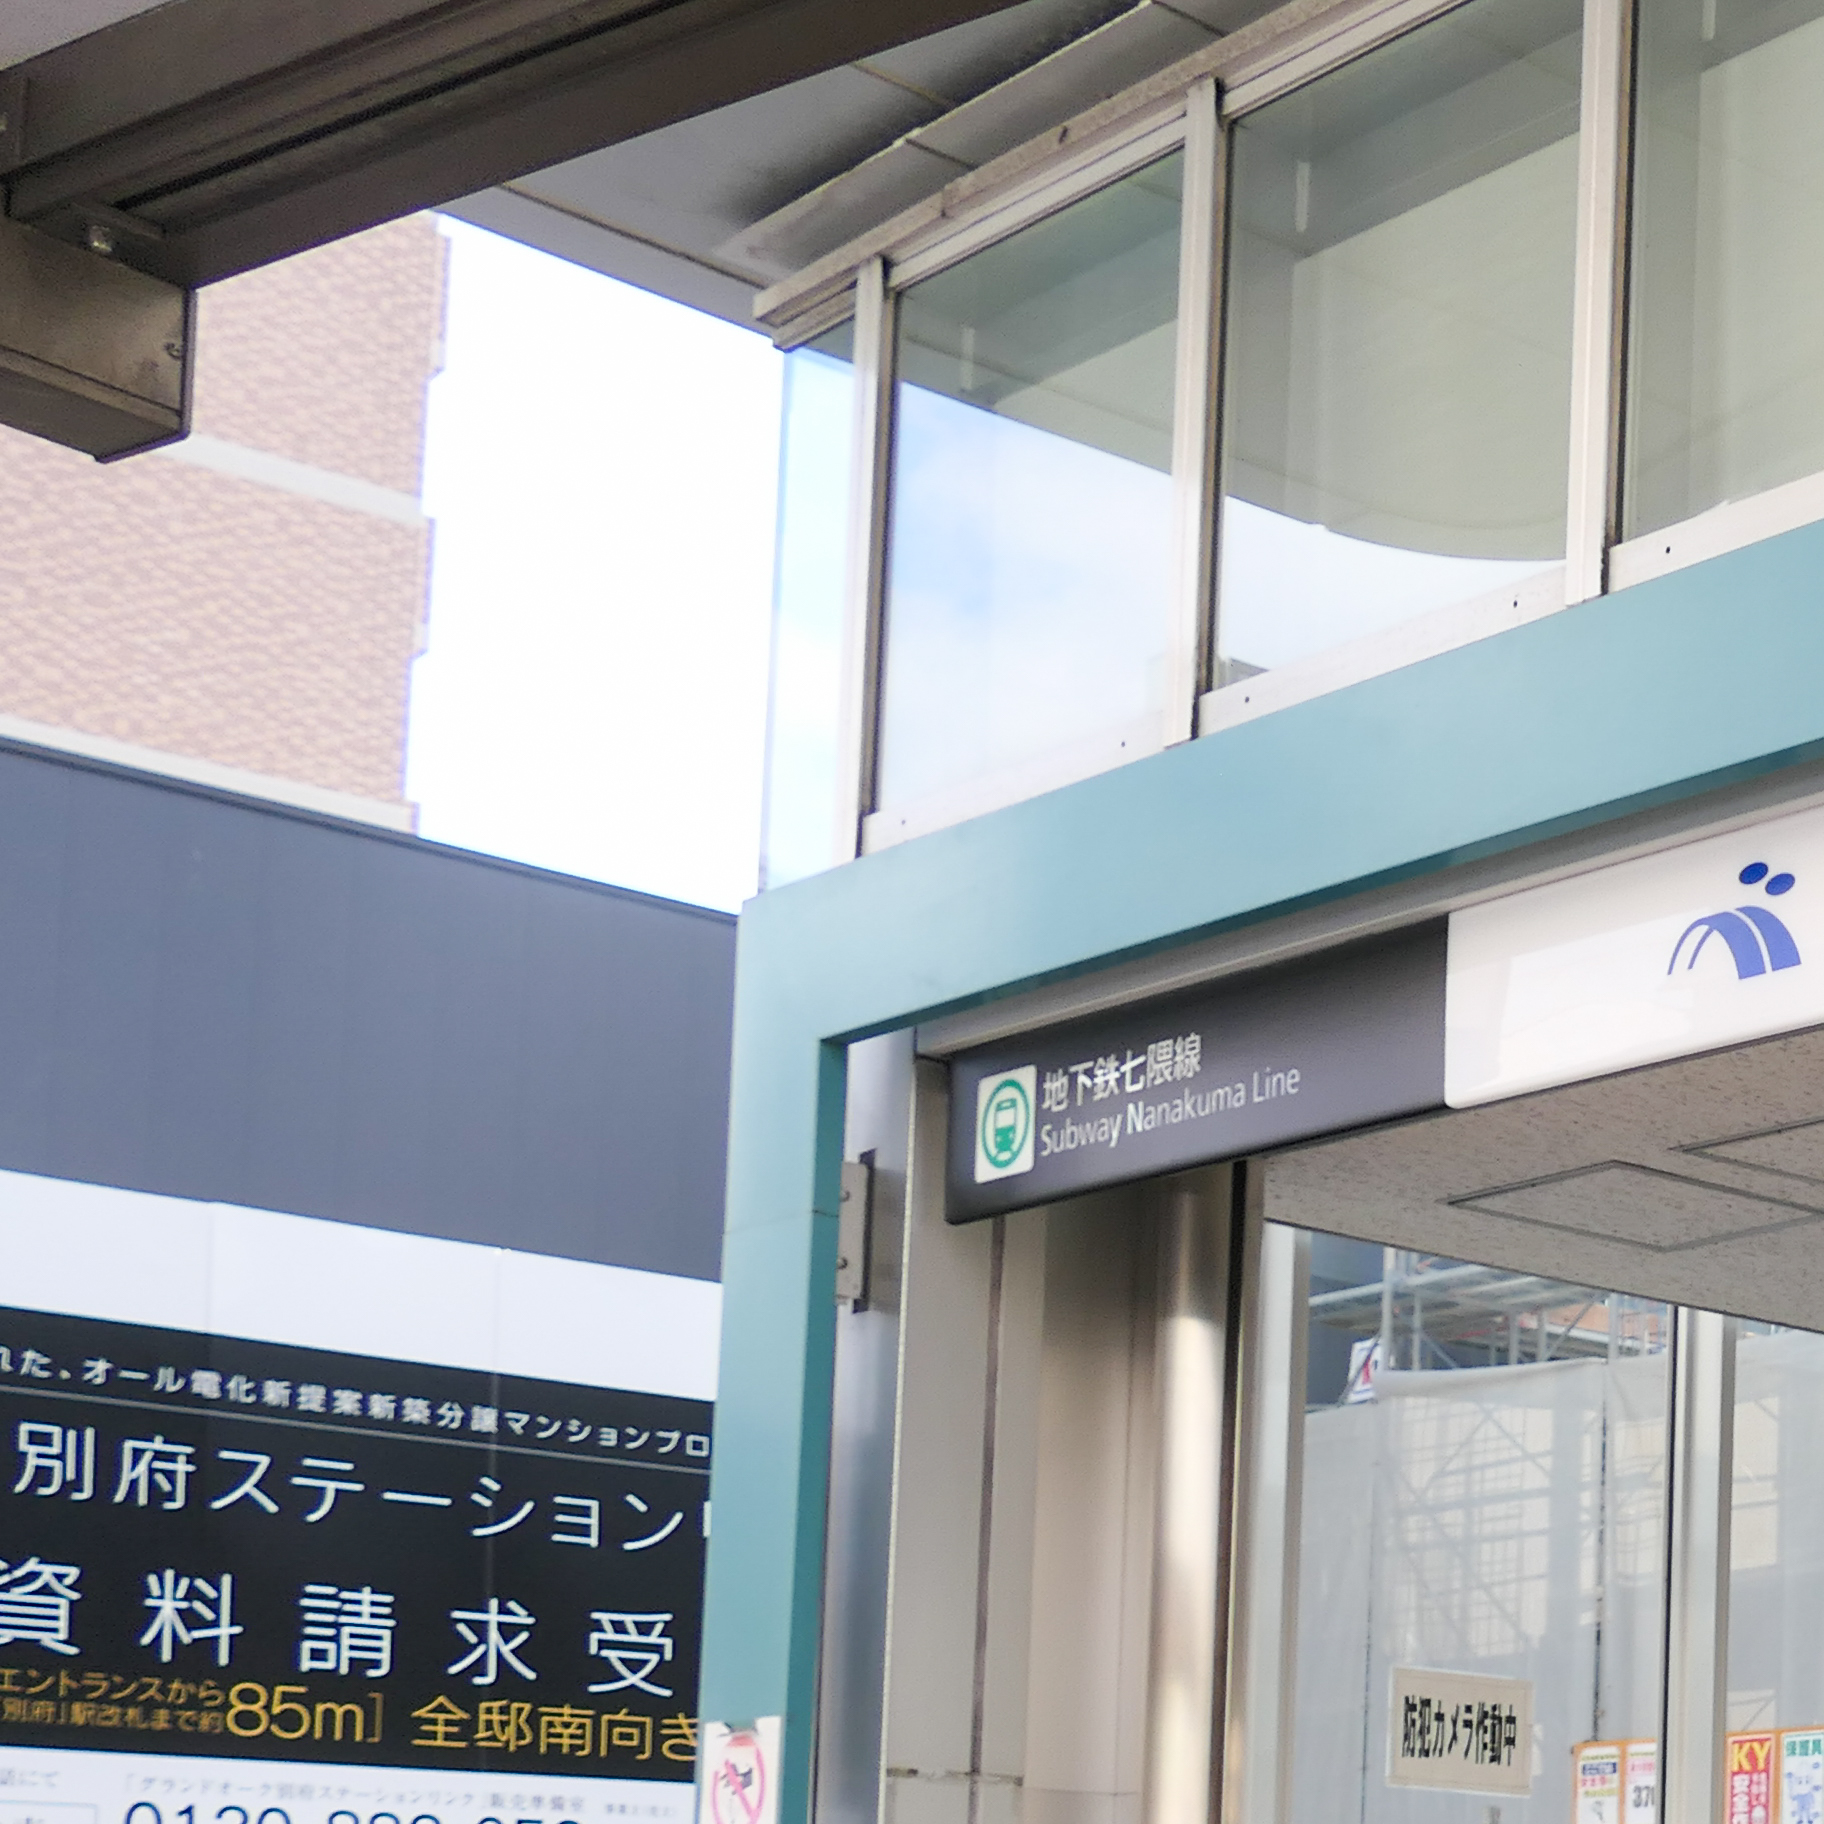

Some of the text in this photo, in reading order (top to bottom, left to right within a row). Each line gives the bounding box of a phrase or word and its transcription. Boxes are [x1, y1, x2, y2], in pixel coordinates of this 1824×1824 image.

[1042, 1032, 1202, 1112] 地下鉄七隈線
[1040, 1066, 1301, 1159] Subway Nanakuma Line
[1401, 1694, 1517, 1767] 防犯カメラ作動中
[1731, 1740, 1771, 1772] KY
